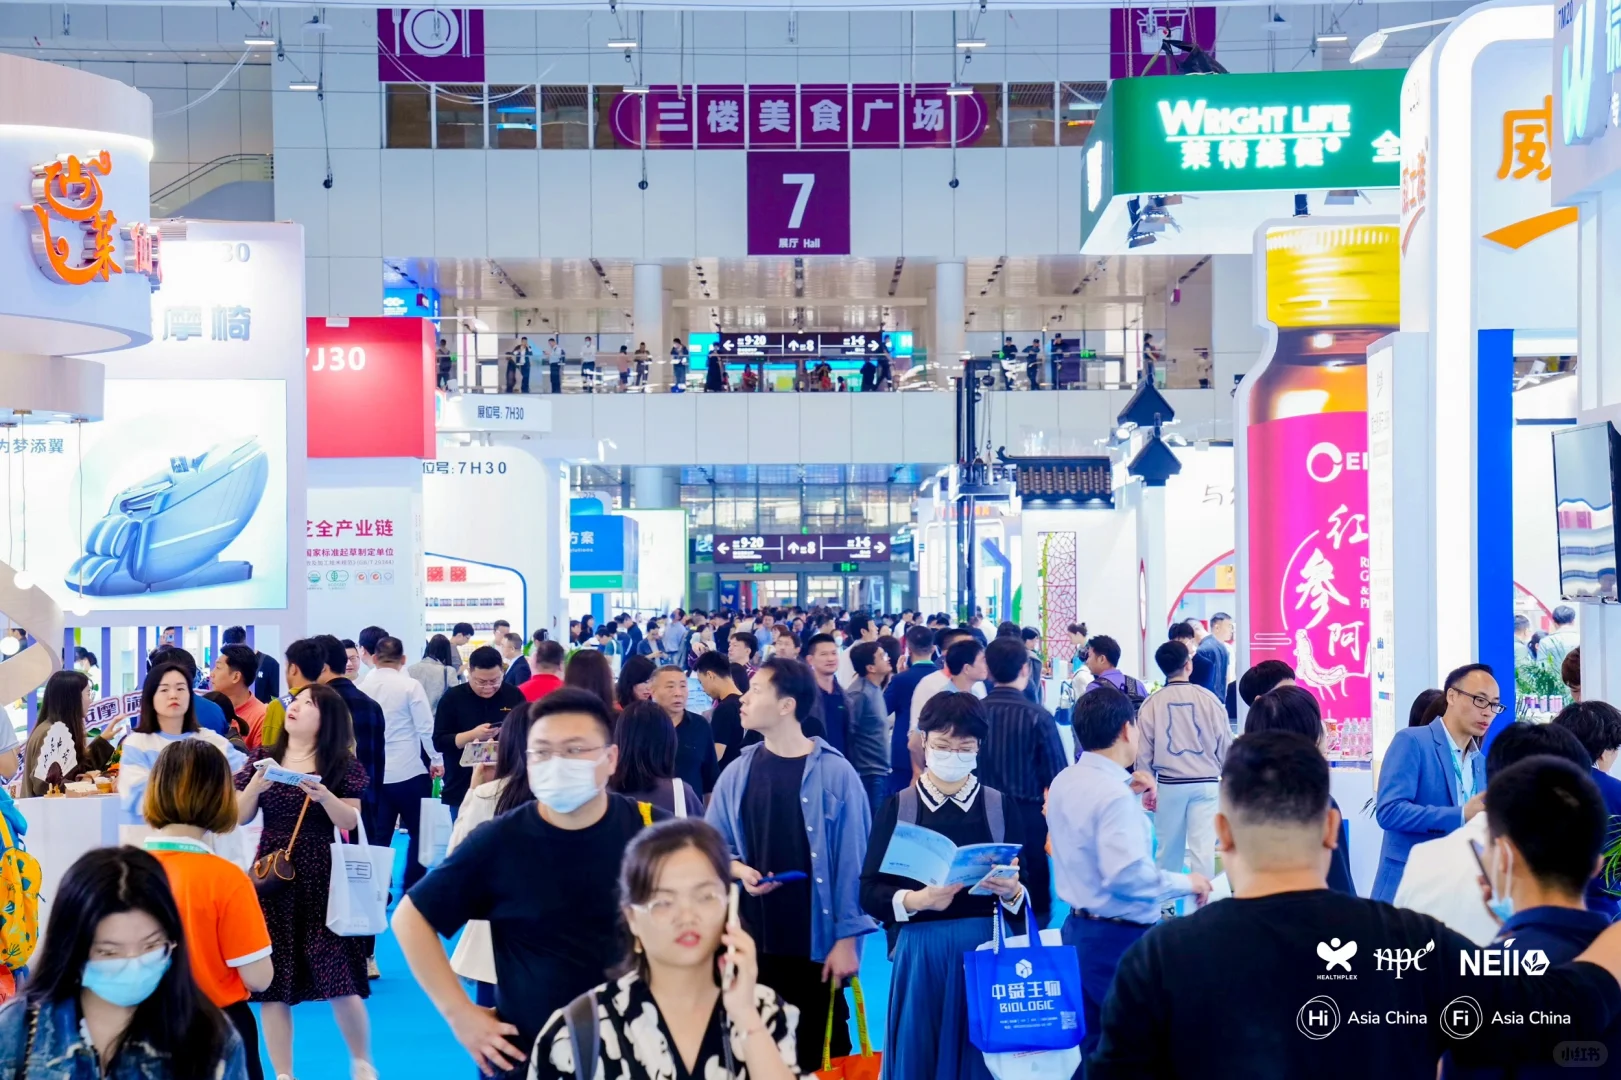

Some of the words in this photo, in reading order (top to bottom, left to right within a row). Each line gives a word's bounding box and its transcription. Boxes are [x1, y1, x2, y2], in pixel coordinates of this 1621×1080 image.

[656, 98, 945, 133] 三楼美食广场
[1293, 105, 1350, 131] LIFE
[782, 173, 815, 229] 7
[778, 238, 799, 249] 展厅
[803, 238, 821, 249] Hall
[505, 406, 525, 420] 7H30
[999, 1000, 1055, 1013] BIOLOGIC
